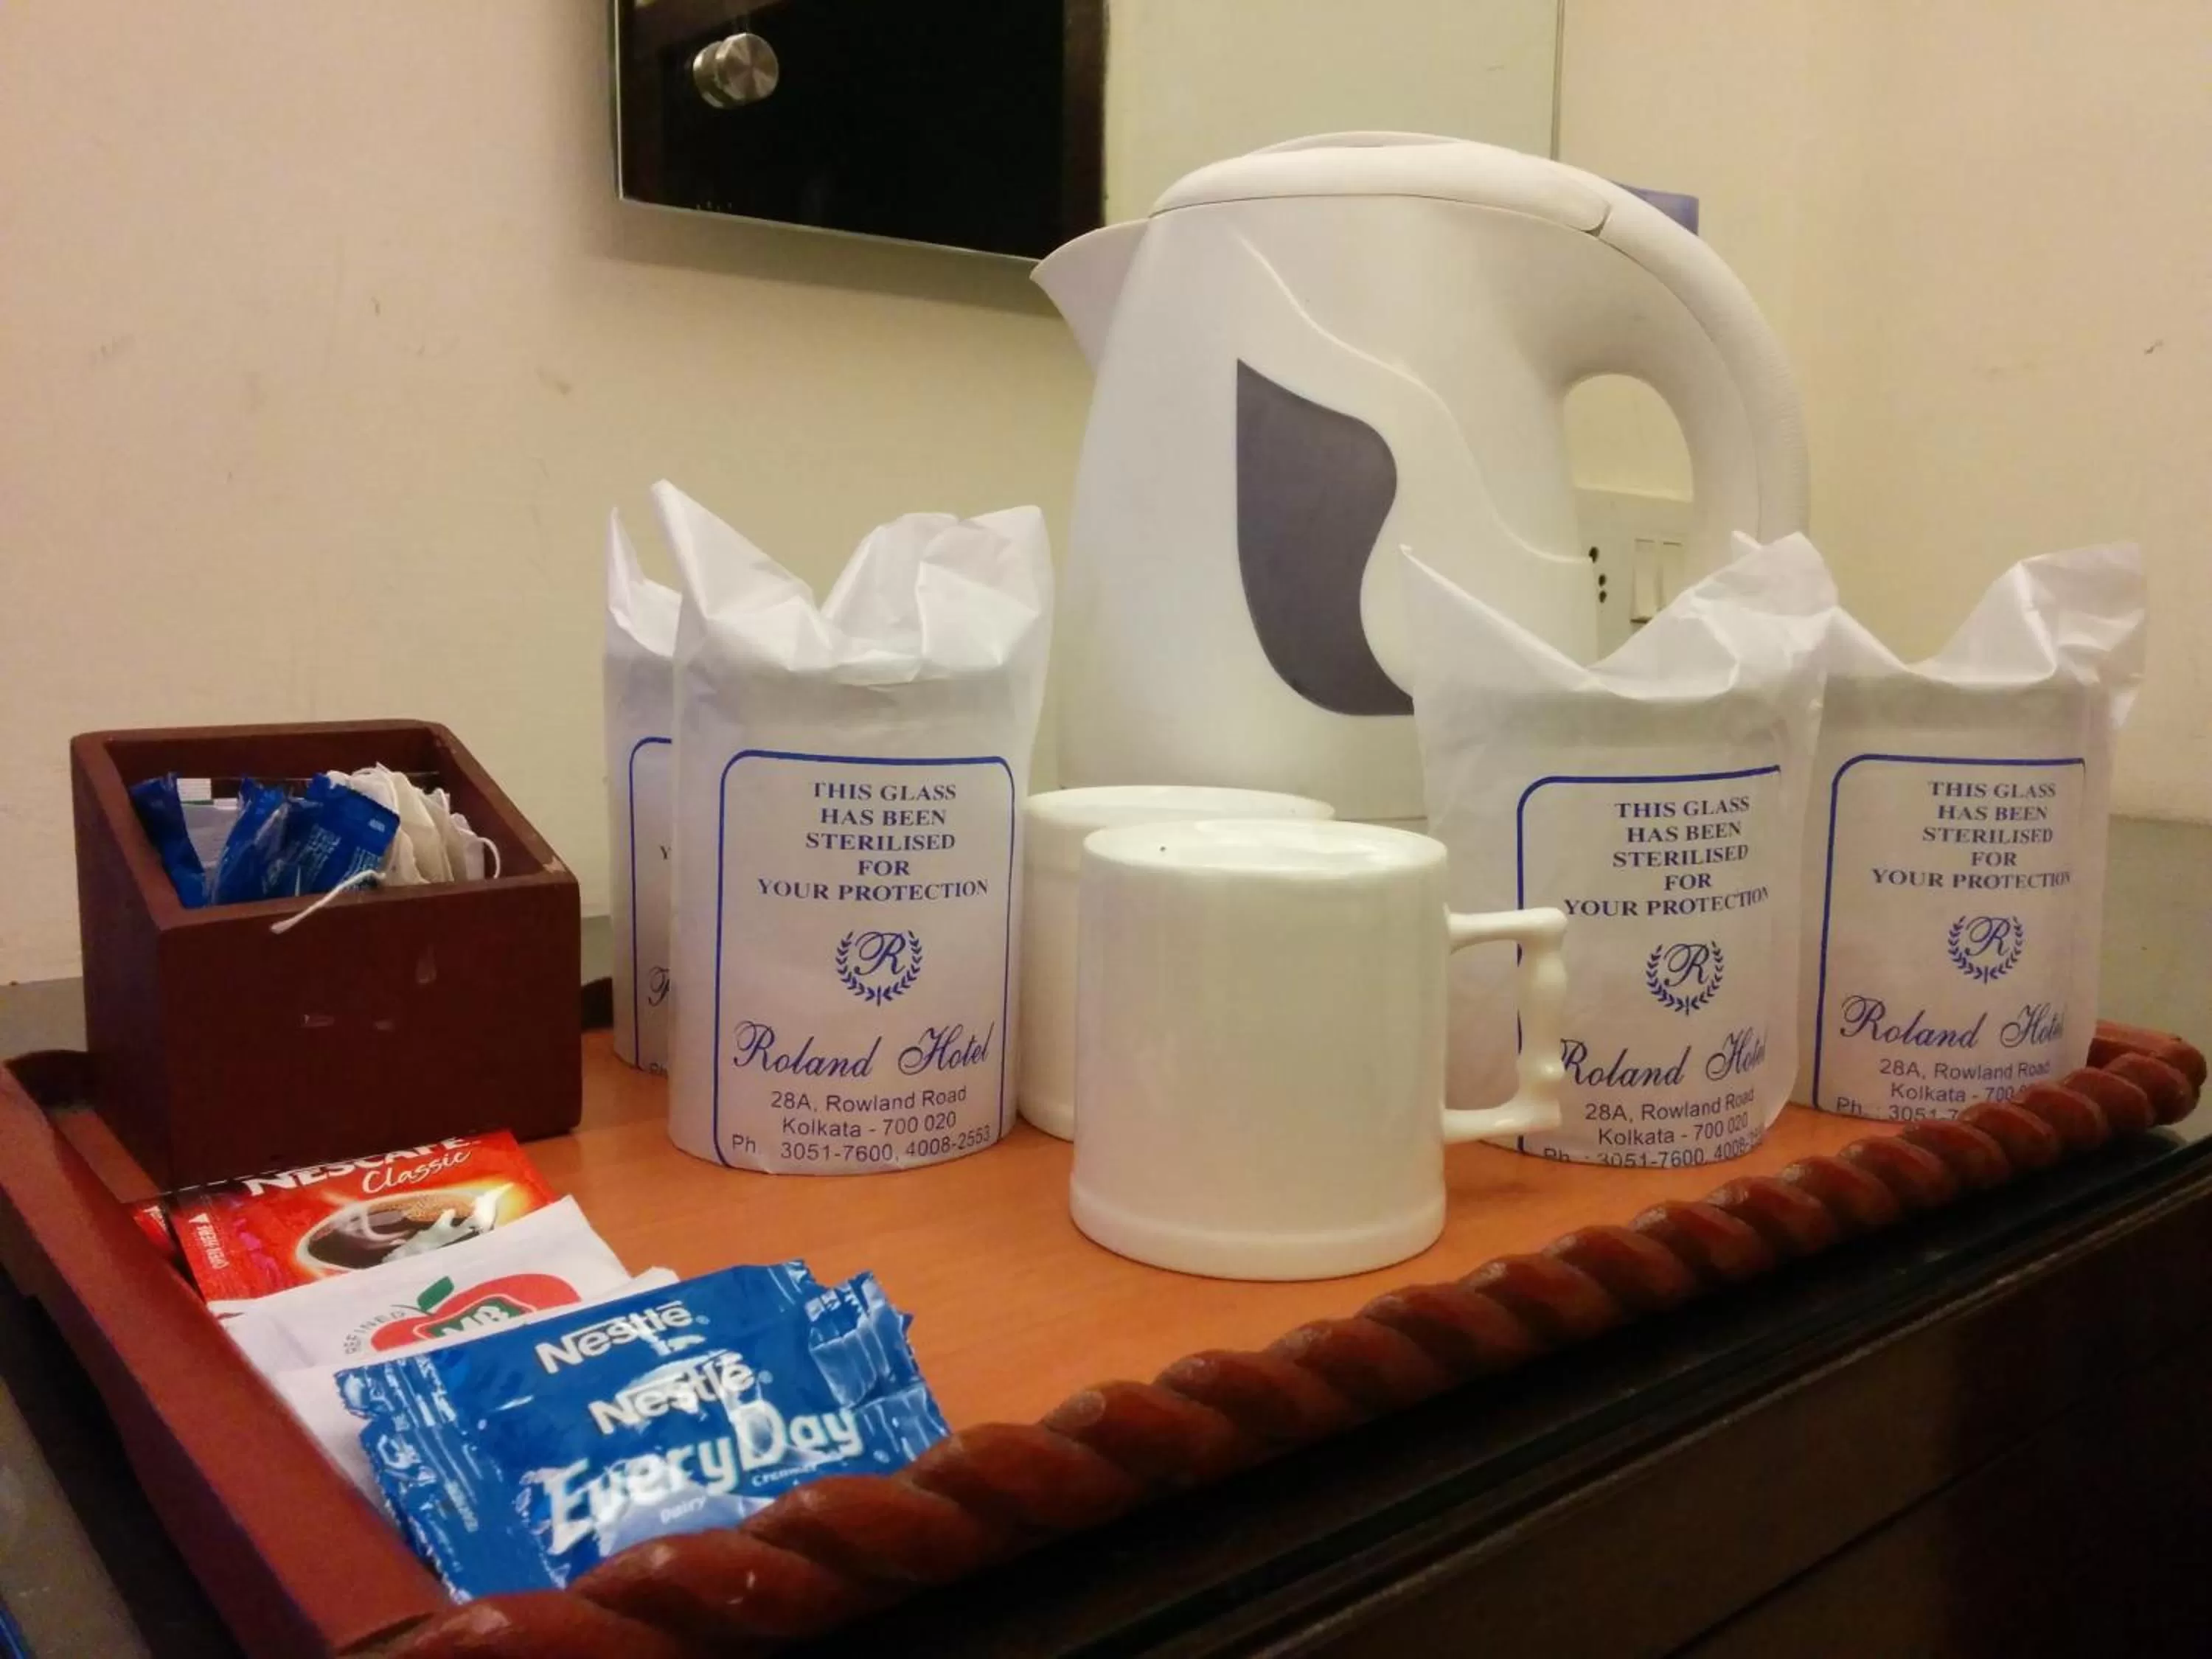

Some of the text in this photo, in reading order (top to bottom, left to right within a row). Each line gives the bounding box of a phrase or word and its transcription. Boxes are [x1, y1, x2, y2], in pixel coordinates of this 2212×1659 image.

[813, 782, 956, 801] THIS GLASS
[1928, 781, 2056, 799] THIS GLASS
[821, 809, 946, 826] HAS BEEN
[1615, 796, 1750, 818] THIS GLASS
[1938, 805, 2048, 821] HAS BEEN
[806, 833, 956, 851] STERILISED
[1627, 821, 1741, 844] HAS BEEN
[1923, 827, 2053, 844] STERILISED
[1613, 844, 1748, 868] STERILISED
[1972, 852, 2017, 867] FOR
[858, 860, 910, 877] FOR
[1872, 869, 2070, 889] YOUR PROTECTION
[758, 879, 989, 901] YOUR PROTECTION
[1664, 873, 1711, 891] FOR
[1565, 886, 1769, 917] YOUR PROTECTION
[1840, 995, 2063, 1049] Roland Hot
[733, 1020, 995, 1079] Roland Hotel
[1561, 1038, 1691, 1088] Roland
[1934, 1062, 2012, 1080] Rowland
[827, 1092, 915, 1113] Rowland
[922, 1085, 967, 1107] Road
[1891, 1082, 1965, 1102] Kolkata
[1642, 1097, 1720, 1121] Rowland
[1725, 1089, 1754, 1110] Road
[782, 1117, 861, 1138] Kolkata
[883, 1116, 918, 1135] 700
[924, 1111, 956, 1132] 020
[1599, 1128, 1674, 1145] Kolkata
[1694, 1121, 1723, 1141] 700
[362, 1150, 470, 1193] Classic
